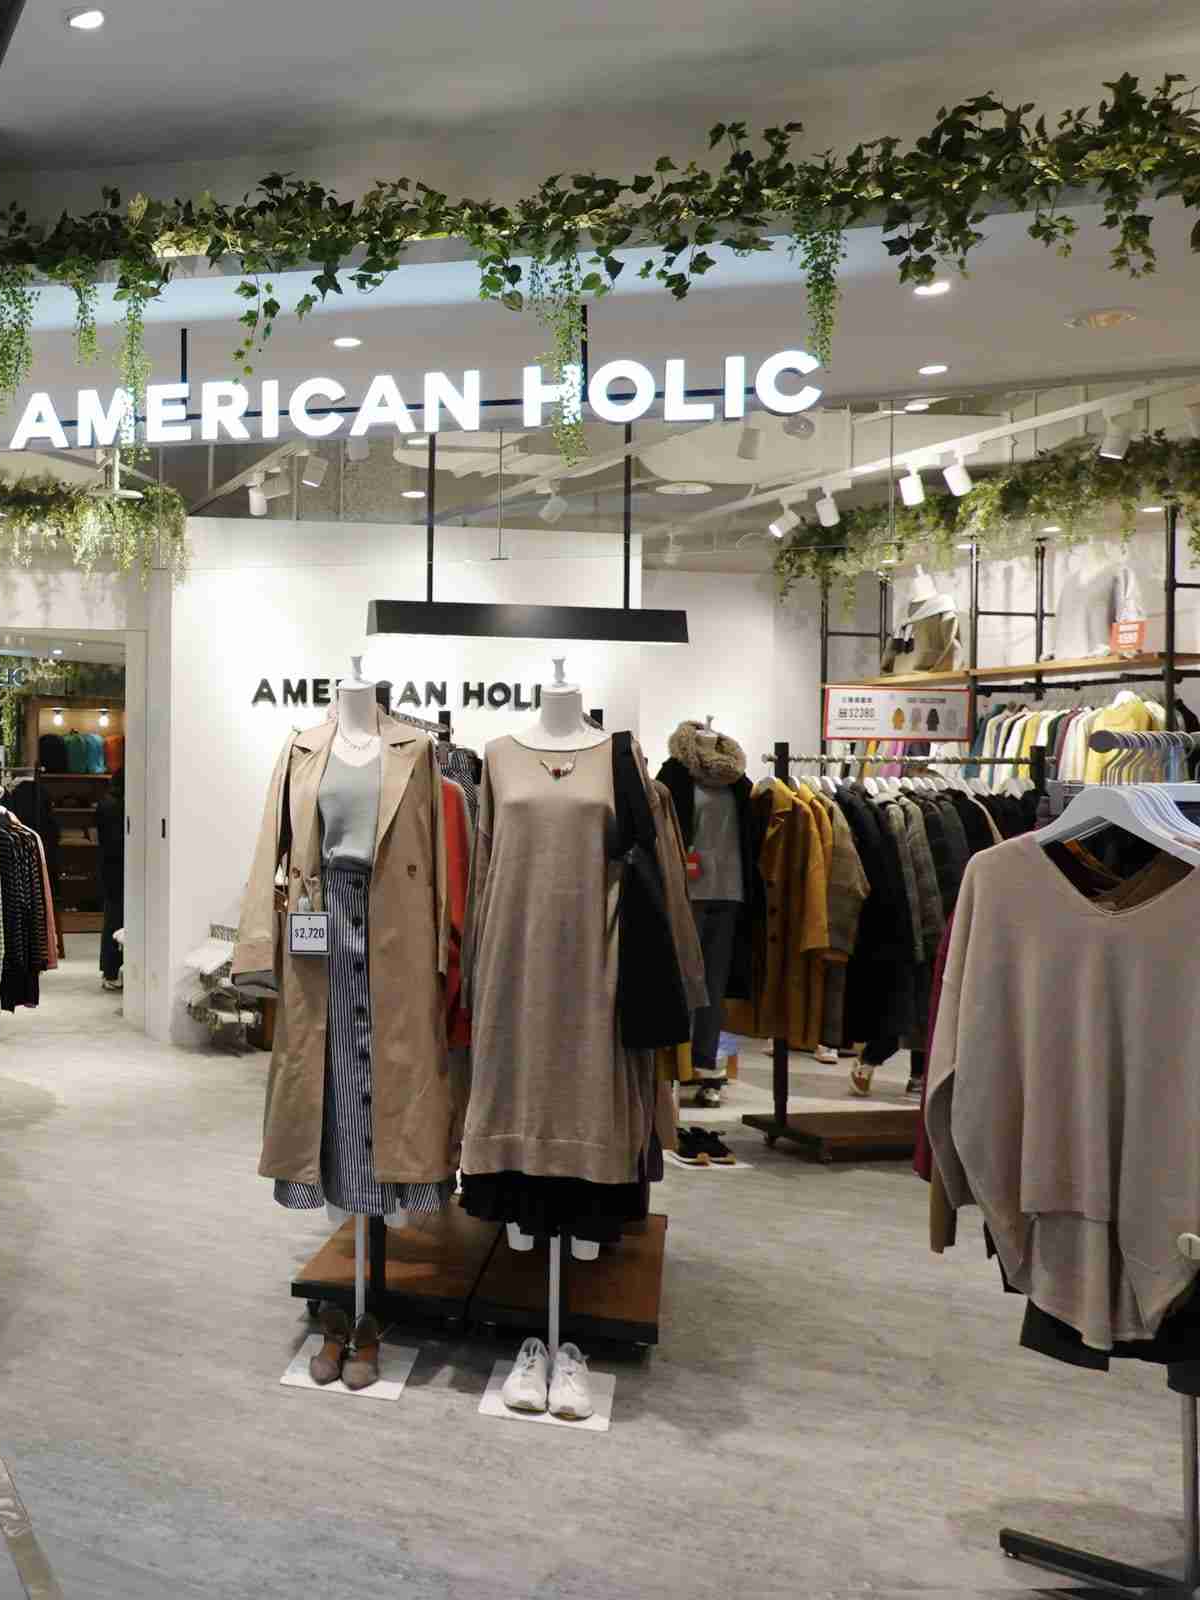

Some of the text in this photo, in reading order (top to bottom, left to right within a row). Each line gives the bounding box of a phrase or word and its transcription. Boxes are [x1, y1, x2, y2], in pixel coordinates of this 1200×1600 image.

[9, 350, 823, 450] AMERICAN HOLIC
[251, 678, 542, 709] AMEAN HOLI
[294, 927, 325, 940] $2,720
